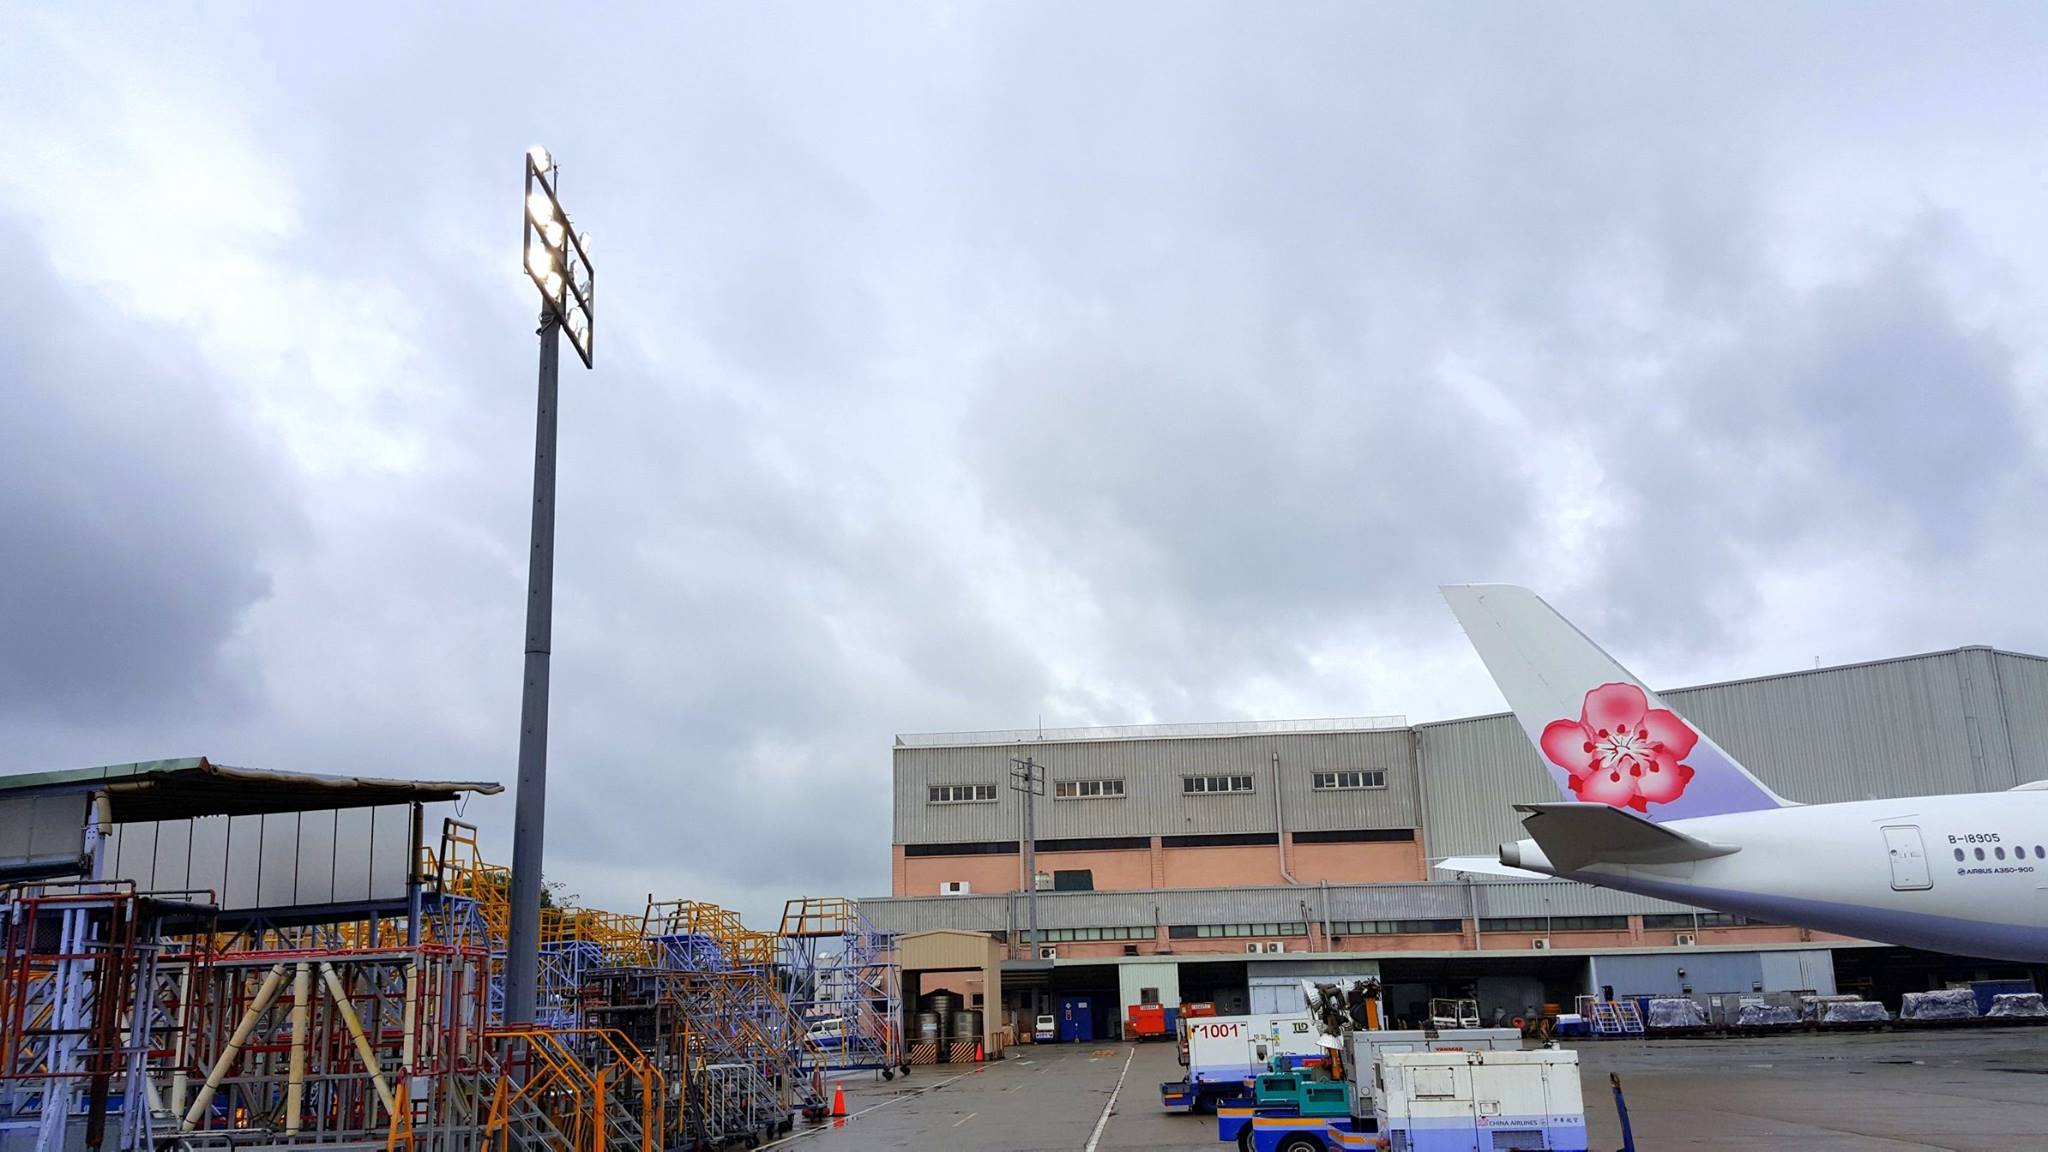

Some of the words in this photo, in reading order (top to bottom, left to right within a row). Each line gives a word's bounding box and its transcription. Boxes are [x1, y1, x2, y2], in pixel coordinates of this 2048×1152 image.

[1947, 833, 2001, 844] B-18905
[1200, 1024, 1239, 1039] 1001
[1510, 1119, 1538, 1127] AIRLINES
